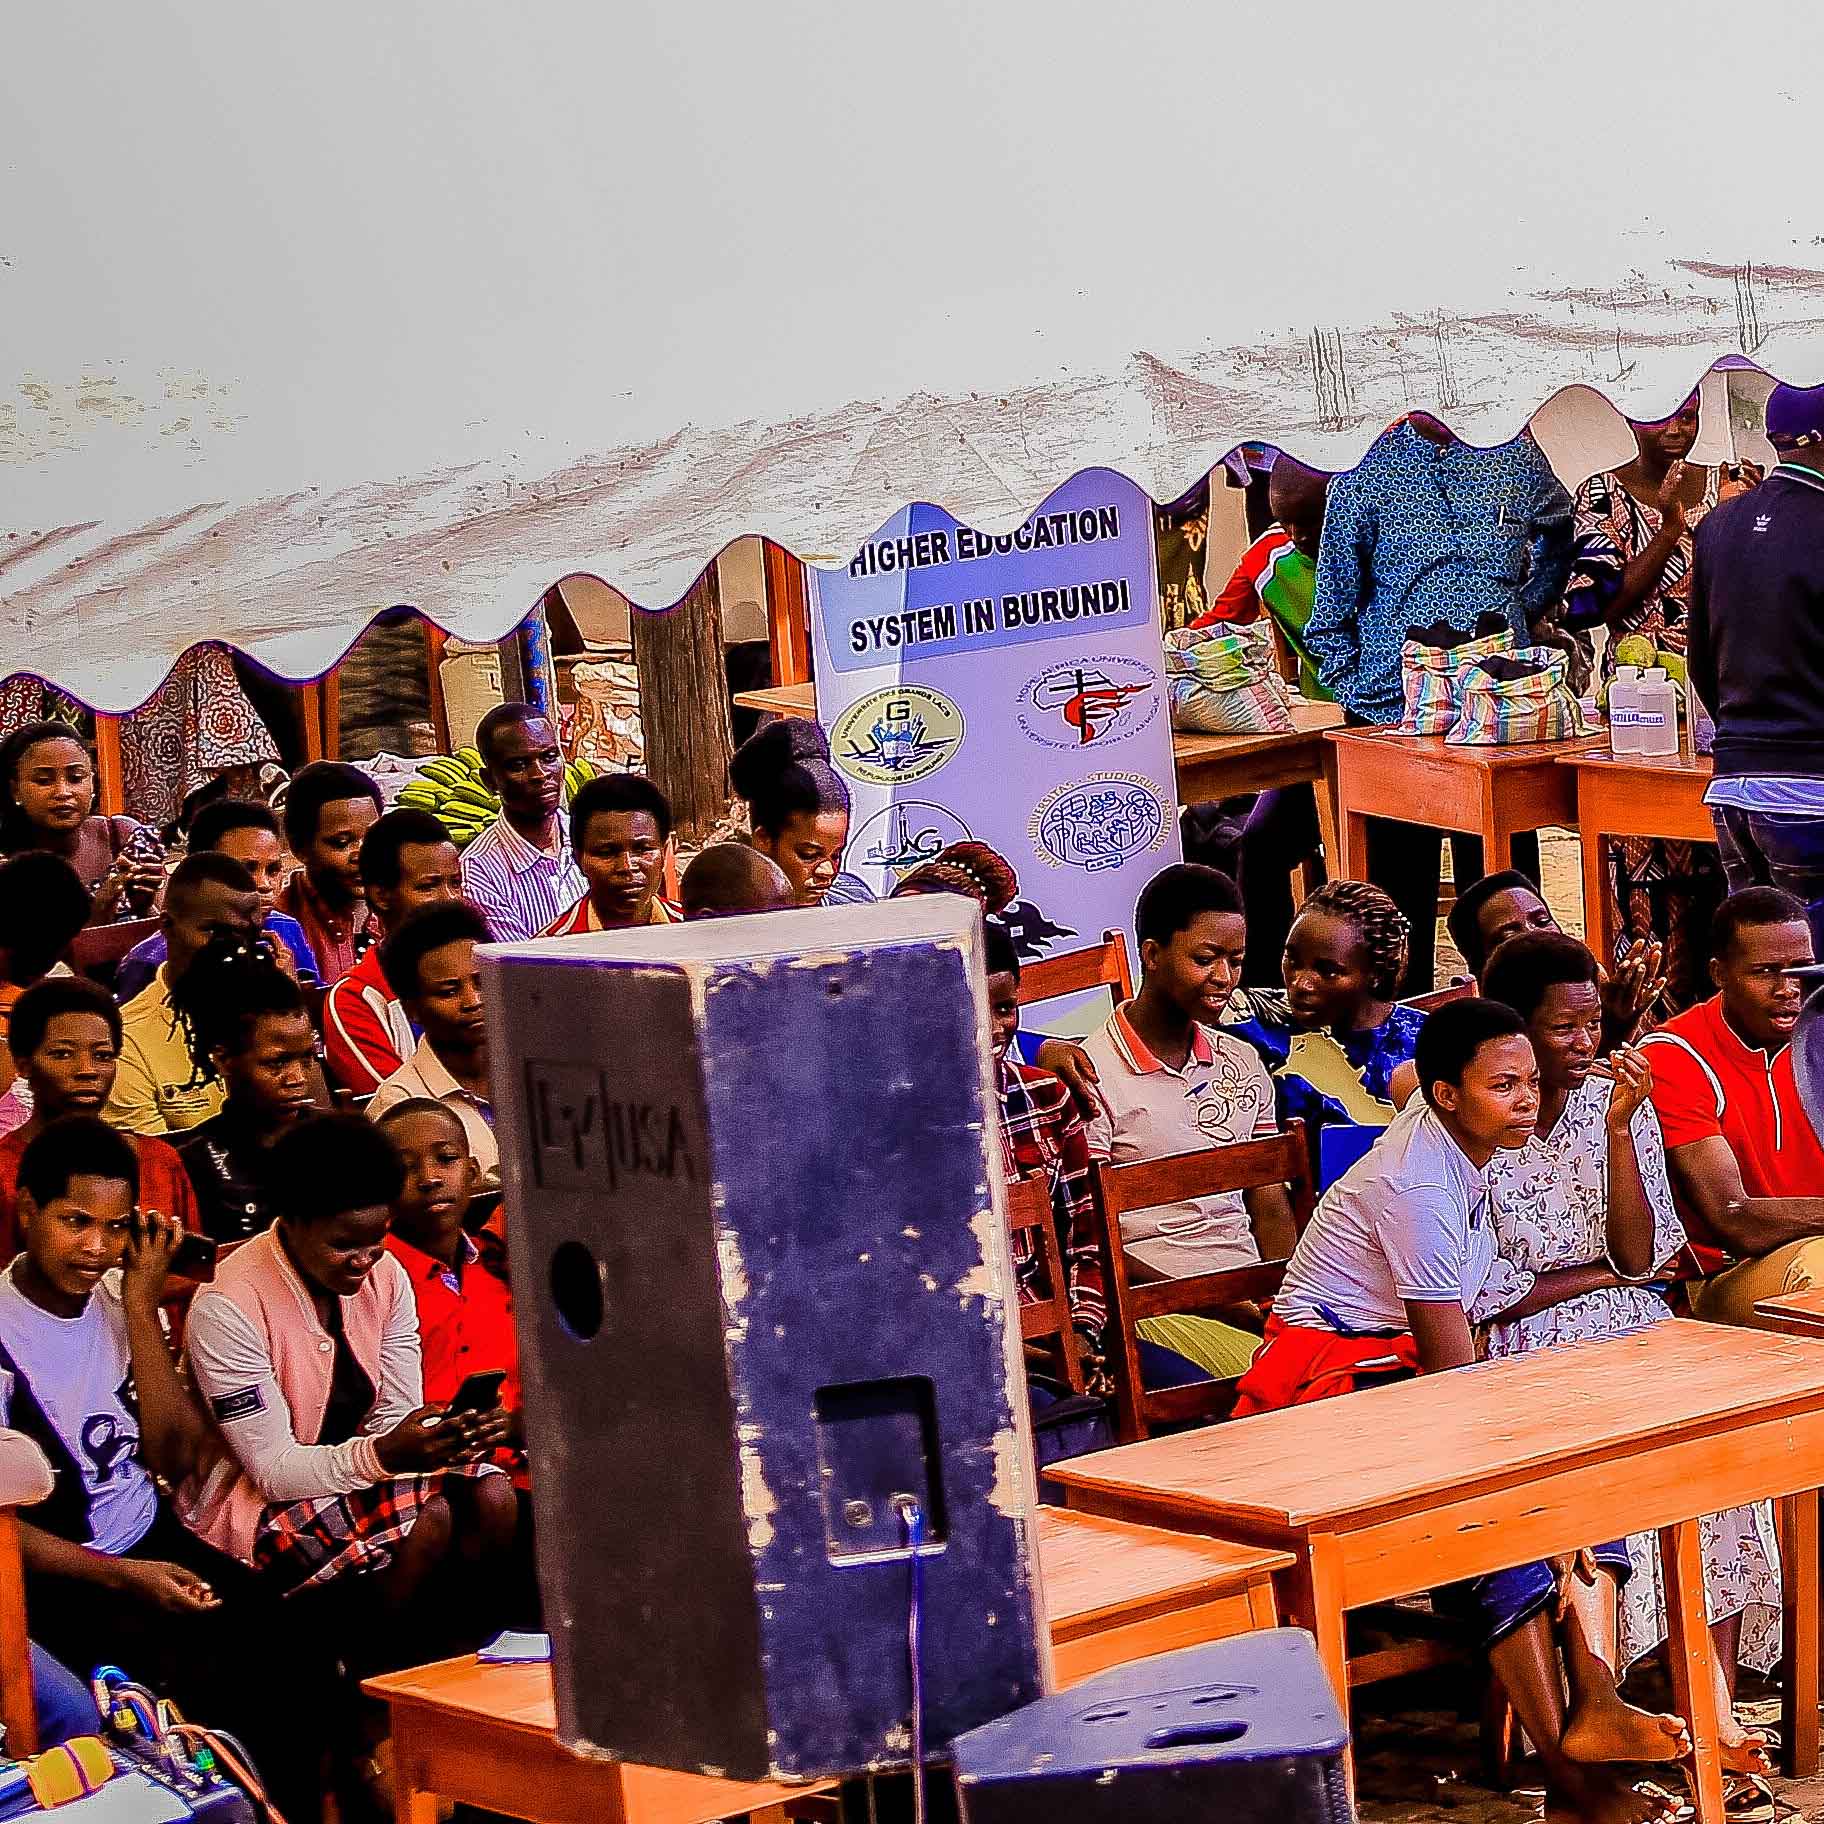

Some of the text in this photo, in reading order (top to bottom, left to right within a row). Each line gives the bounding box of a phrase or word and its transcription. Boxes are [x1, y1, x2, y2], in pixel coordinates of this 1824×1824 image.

[848, 505, 1120, 579] HIGHER EDUCATION
[850, 578, 1131, 653] SYSTEM IN BURUNDI
